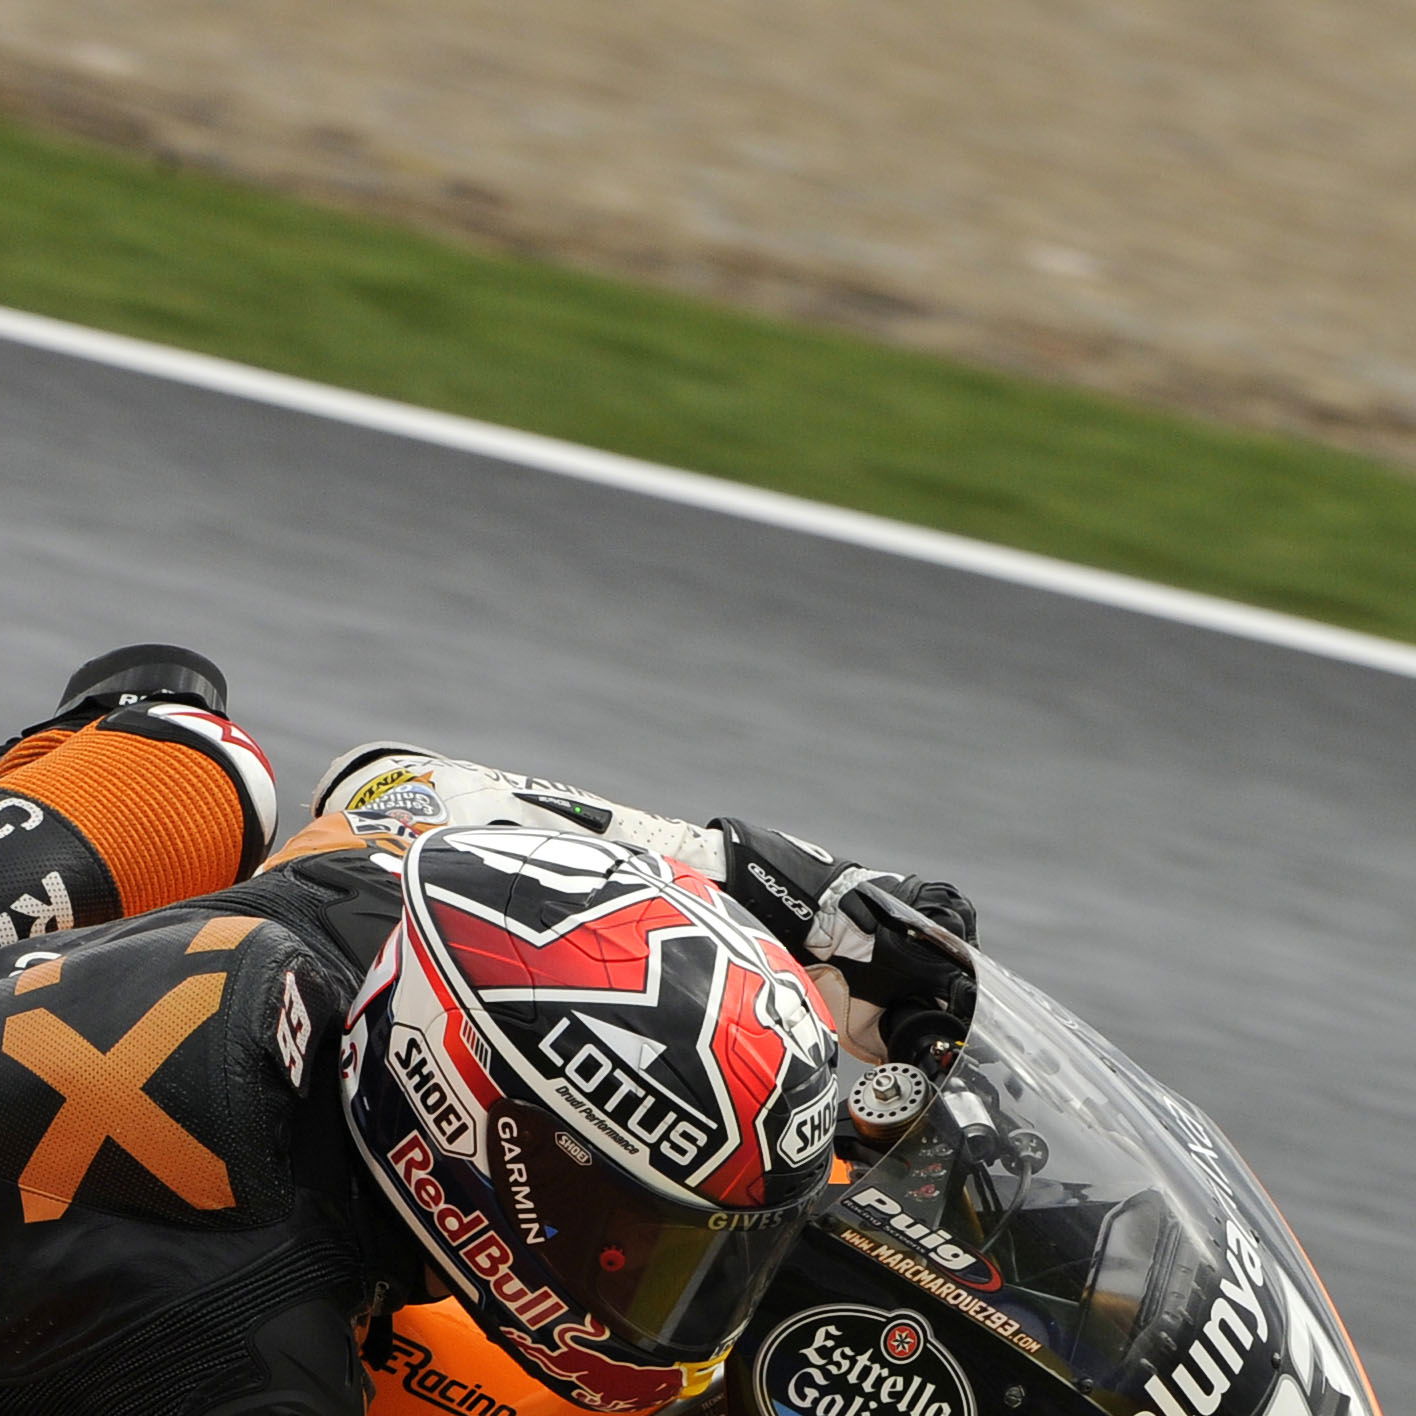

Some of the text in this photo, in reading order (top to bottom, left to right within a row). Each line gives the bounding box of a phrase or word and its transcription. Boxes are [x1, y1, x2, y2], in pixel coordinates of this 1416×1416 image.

[0, 917, 267, 1224] X
[394, 1037, 469, 1146] SHOEI
[538, 1016, 708, 1166] LOTUS
[497, 1117, 546, 1244] GARMIN
[559, 1135, 589, 1163] SHOEI
[579, 1104, 640, 1156] Performance
[387, 1129, 569, 1331] Red Bull
[708, 1211, 784, 1231] GIVES
[851, 1187, 977, 1270] Puig
